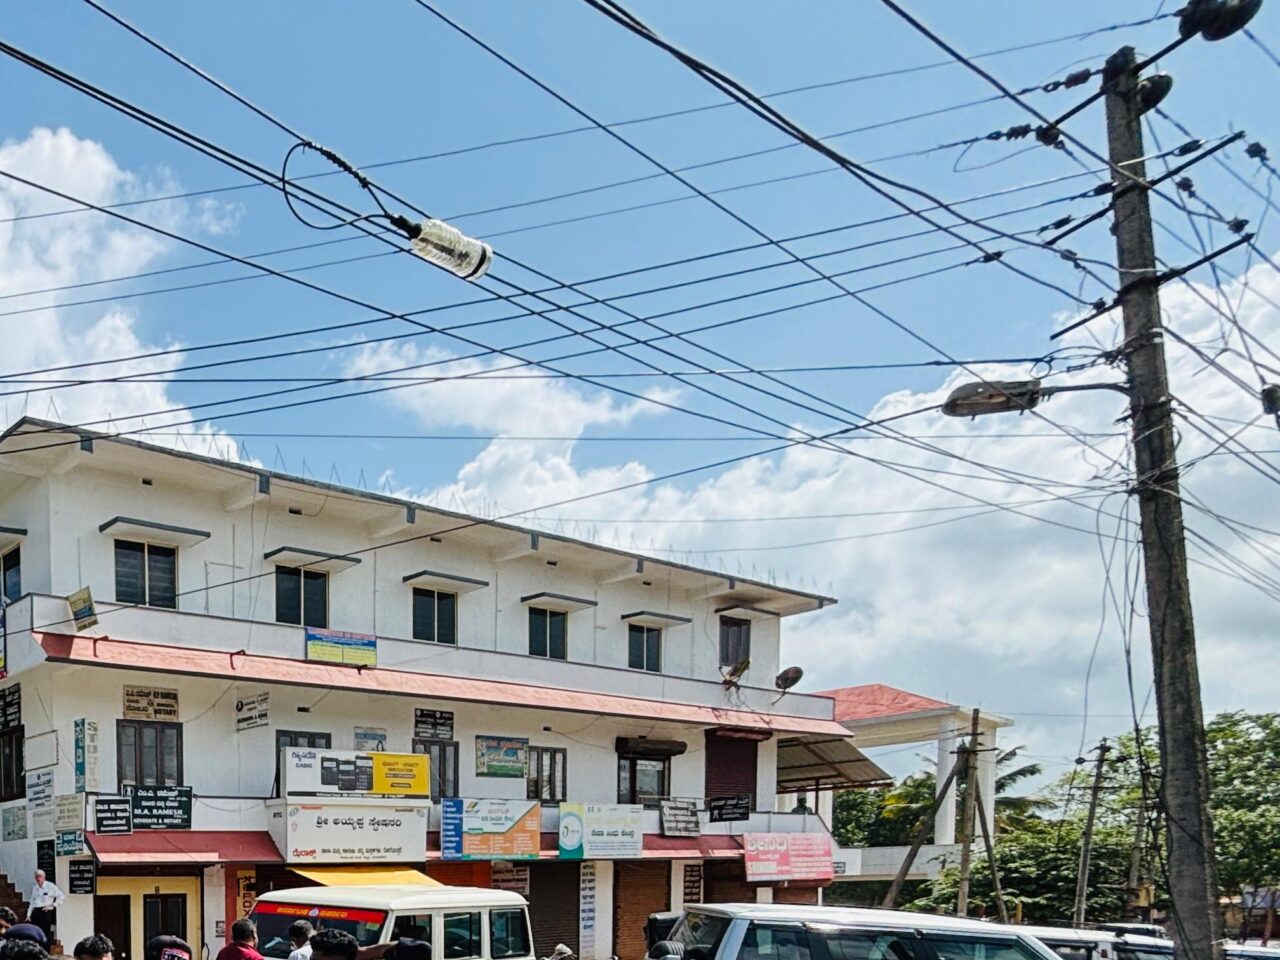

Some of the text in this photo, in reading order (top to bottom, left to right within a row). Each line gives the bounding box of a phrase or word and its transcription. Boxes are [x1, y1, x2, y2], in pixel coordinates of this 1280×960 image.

[316, 816, 402, 831] ಶ್ರೀ ಅಯ್ಯಪ್ಪ ಸ್ಟೇಷನರಿ
